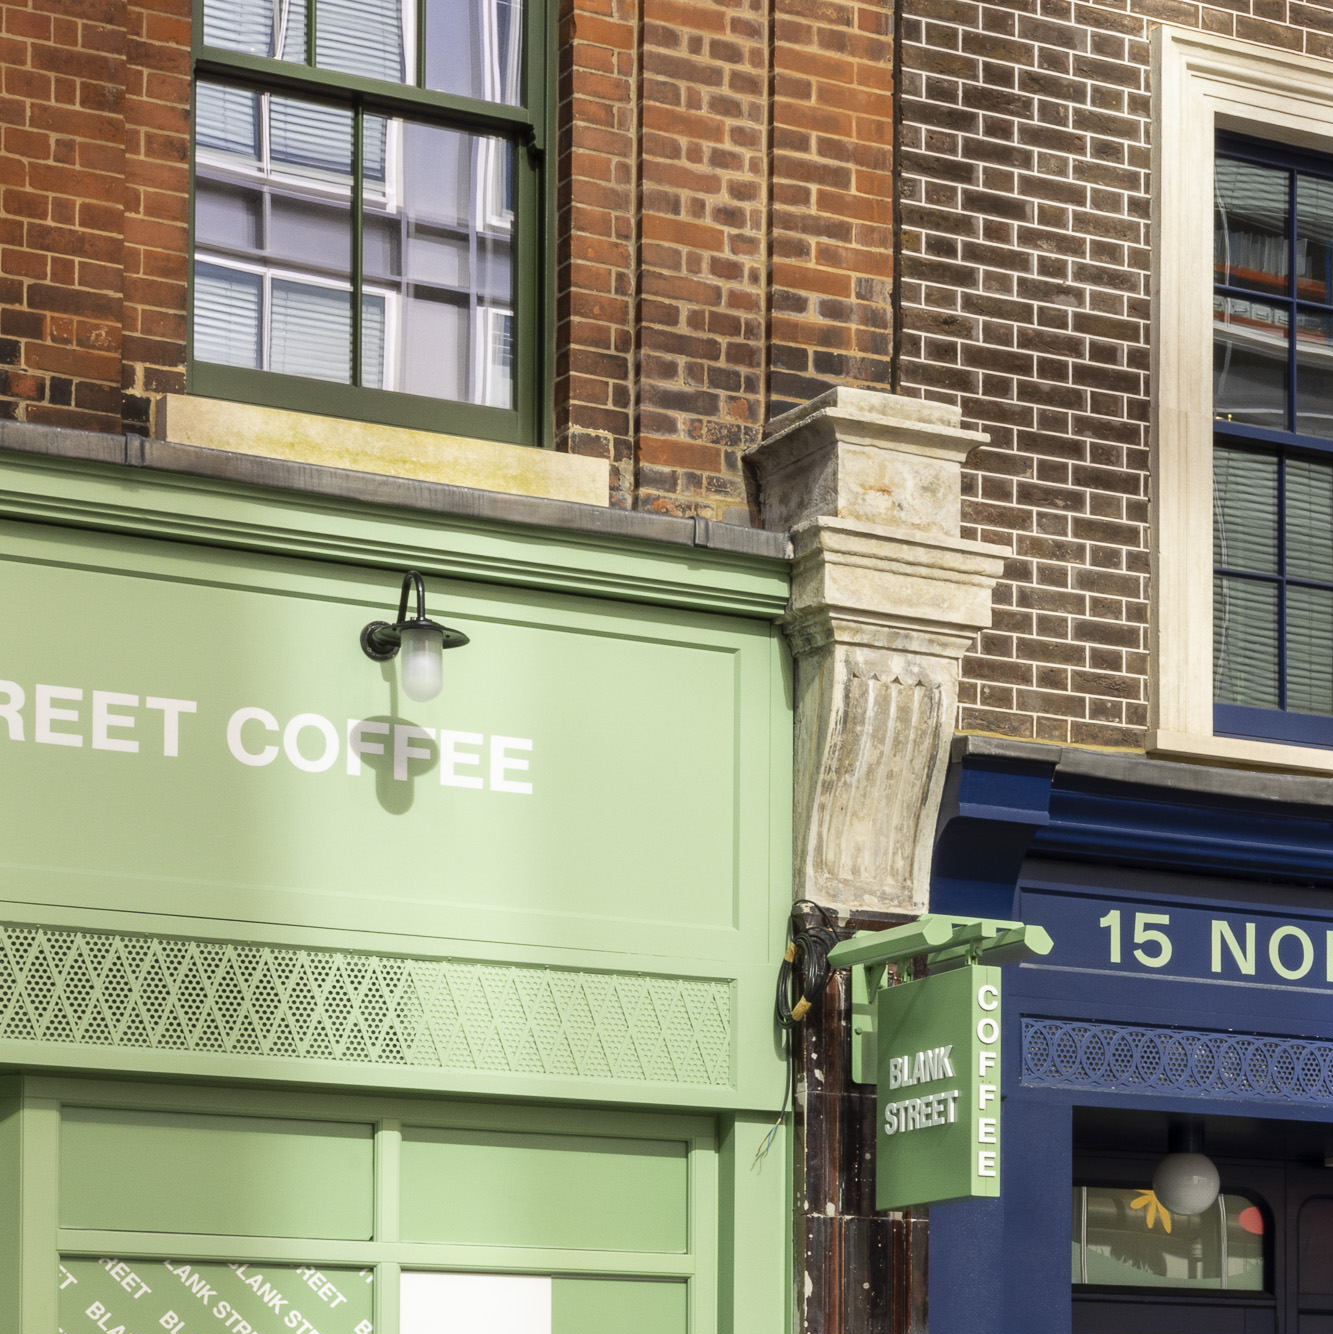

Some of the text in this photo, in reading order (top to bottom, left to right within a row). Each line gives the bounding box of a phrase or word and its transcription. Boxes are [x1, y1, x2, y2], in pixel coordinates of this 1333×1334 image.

[227, 706, 533, 795] COFFEE
[1099, 909, 1173, 968] 15
[889, 1045, 954, 1090] BLANK
[977, 985, 999, 1177] COFFEE
[884, 1089, 959, 1136] STREET
[228, 1264, 288, 1314] LANK
